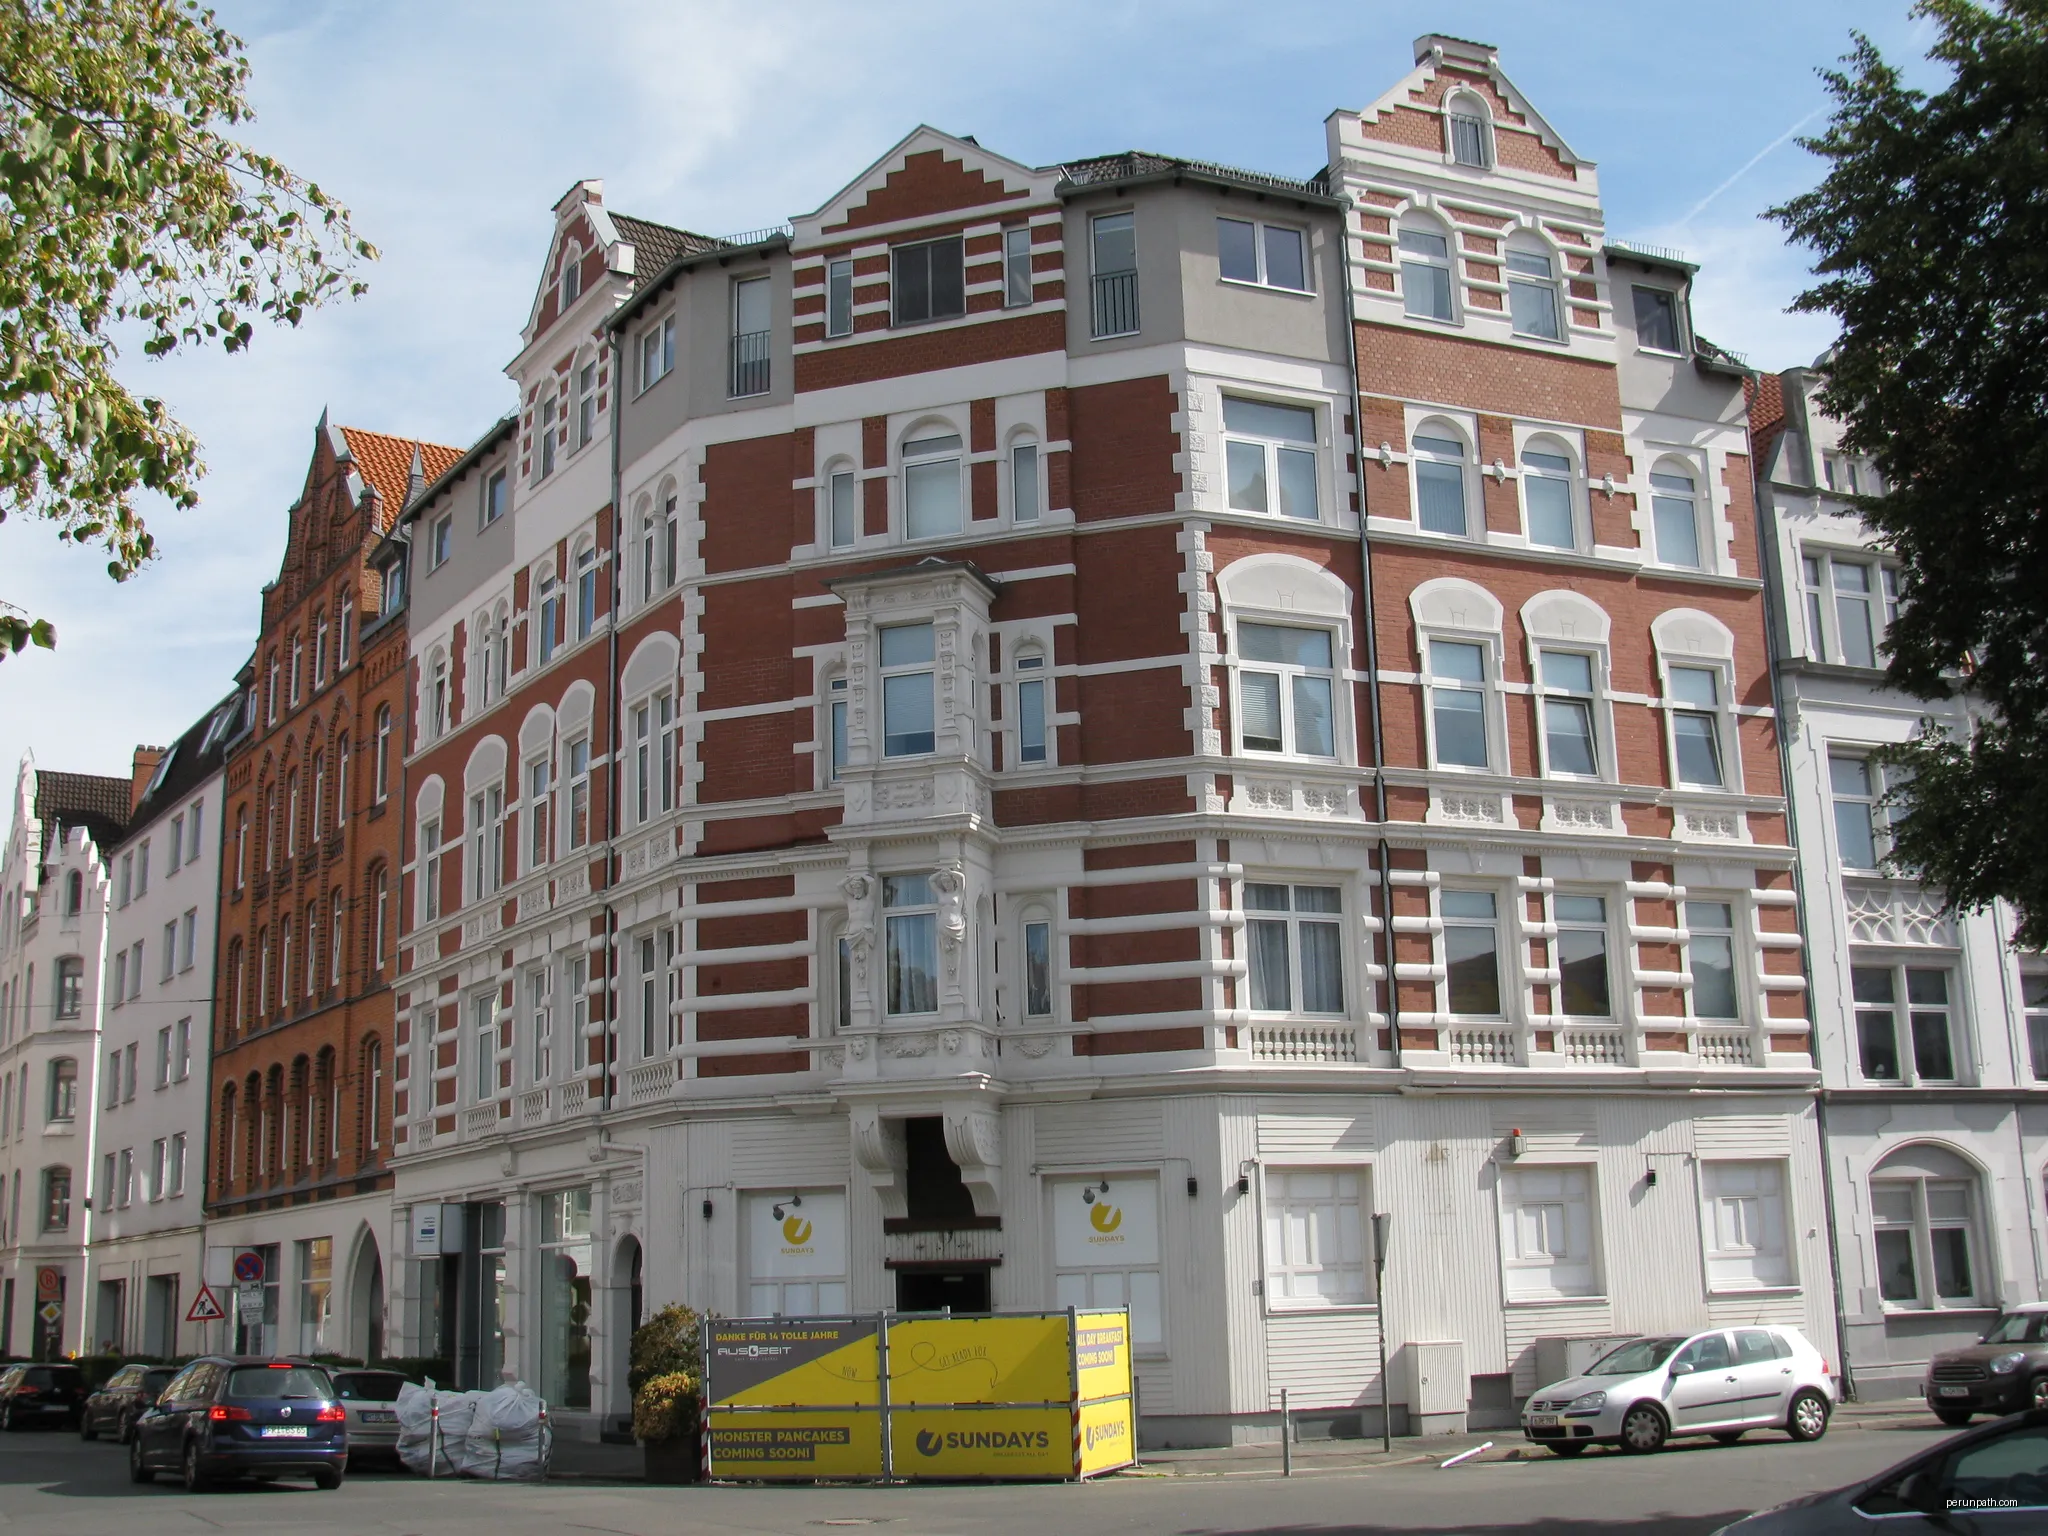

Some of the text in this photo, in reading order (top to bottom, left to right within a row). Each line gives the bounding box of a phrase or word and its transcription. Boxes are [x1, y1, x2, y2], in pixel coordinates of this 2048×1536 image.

[1088, 1234, 1125, 1243] SUNDAYS
[715, 1331, 839, 1341] DANKE FÜR 14 TOLLE JAHRE
[1077, 1330, 1123, 1347] ALL DAY BREAKFAST
[1077, 1352, 1097, 1366] COMING
[712, 1431, 845, 1442] MONSTER PANCAKES
[1095, 1420, 1125, 1442] SUNDAYS
[946, 1431, 1049, 1448] SUNDAYS
[713, 1447, 810, 1458] COMING SOON!
